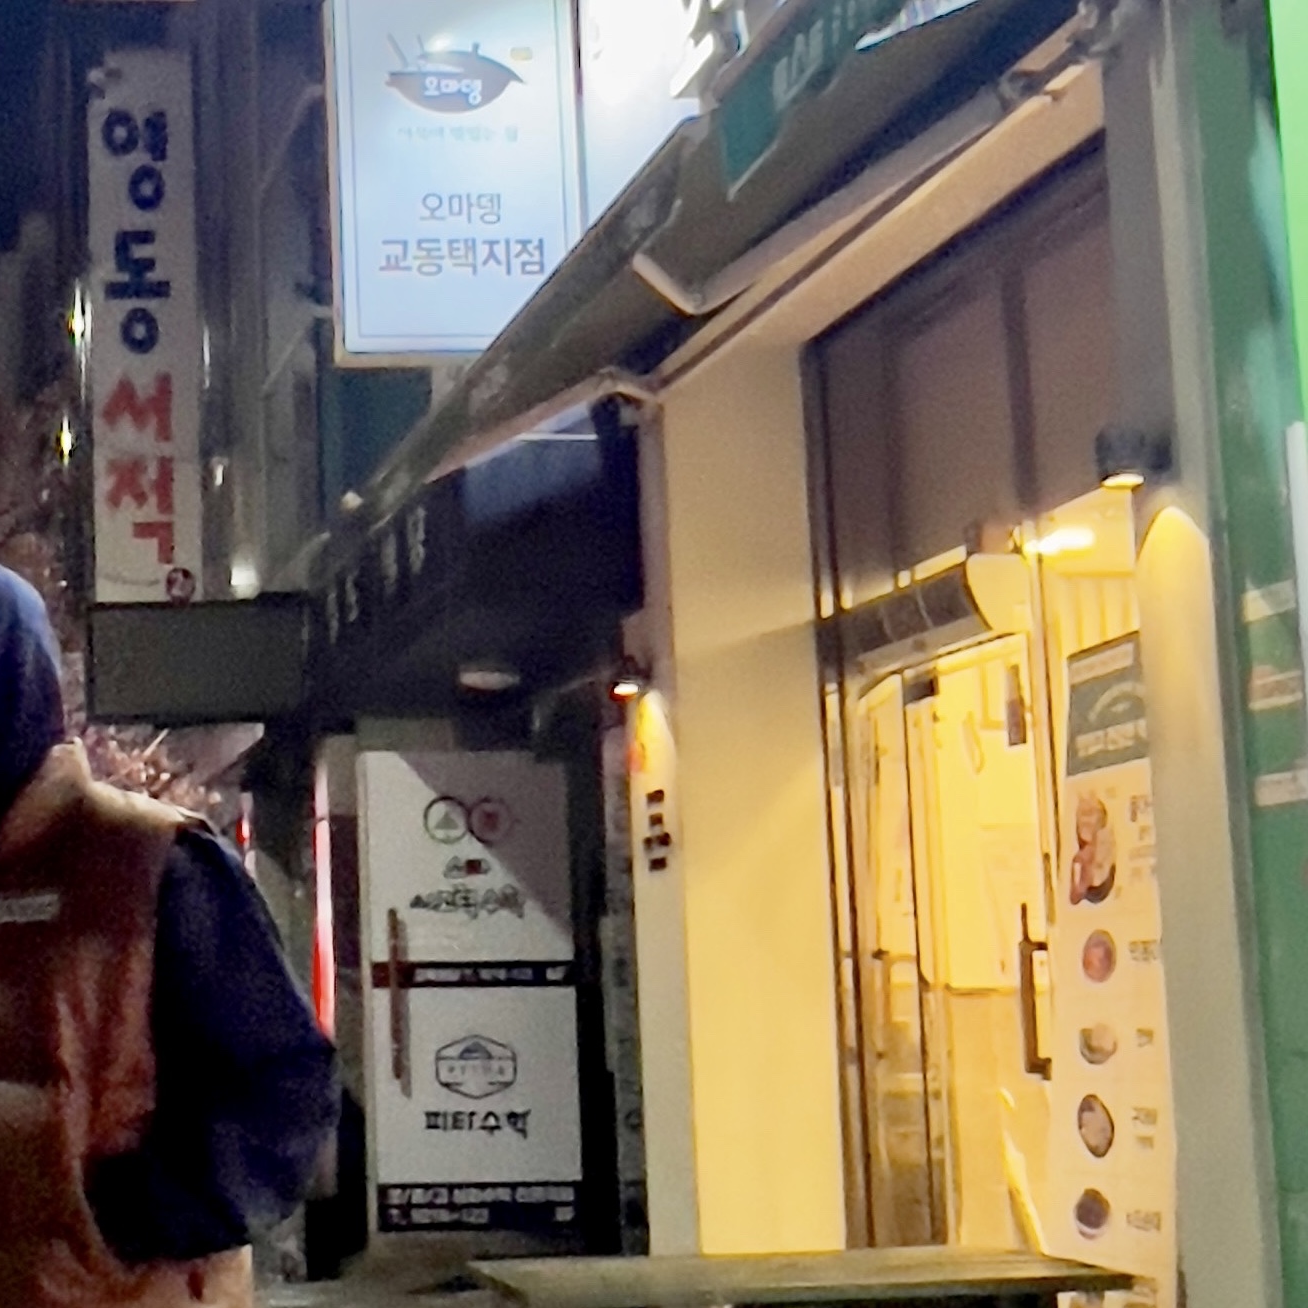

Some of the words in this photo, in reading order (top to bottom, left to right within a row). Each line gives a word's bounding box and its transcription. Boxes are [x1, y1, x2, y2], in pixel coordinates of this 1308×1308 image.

[419, 192, 501, 225] 오마뎅
[379, 236, 545, 277] 교동택지점
[101, 108, 175, 565] 영동서적
